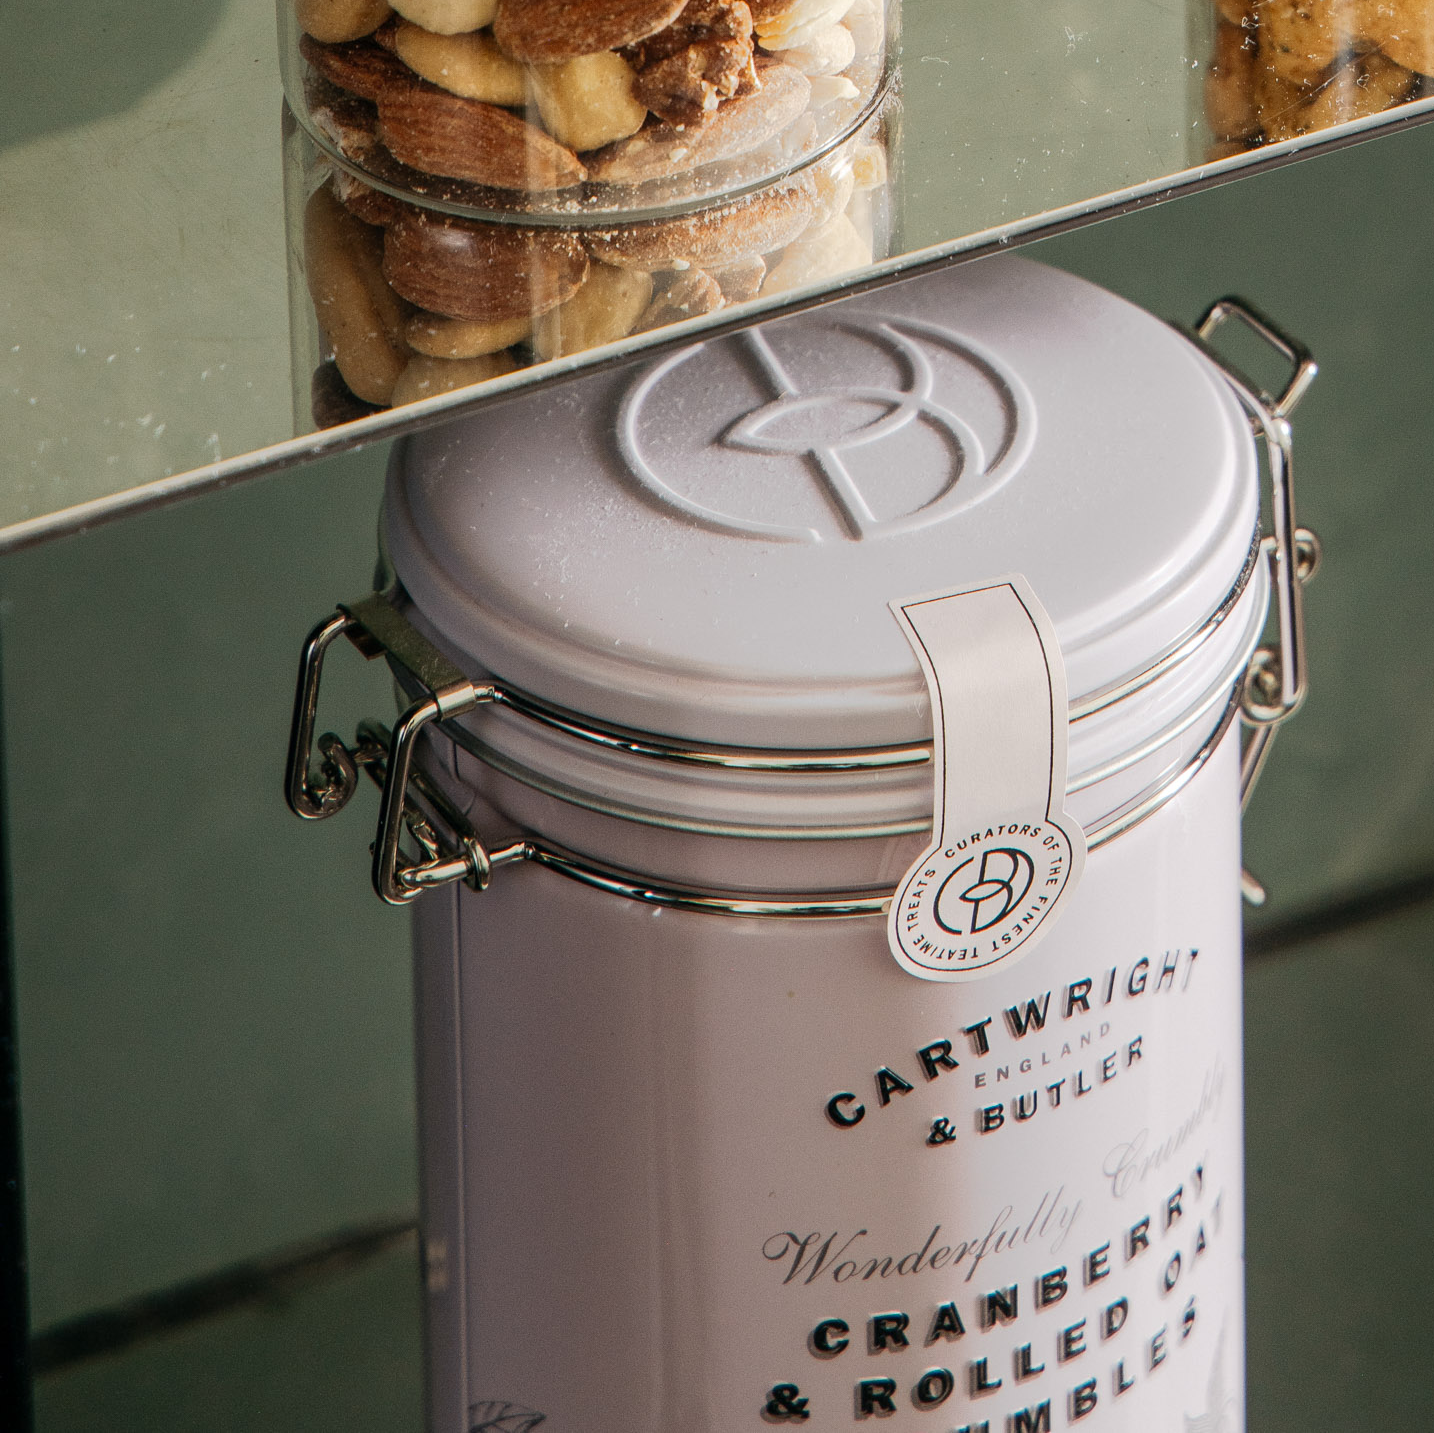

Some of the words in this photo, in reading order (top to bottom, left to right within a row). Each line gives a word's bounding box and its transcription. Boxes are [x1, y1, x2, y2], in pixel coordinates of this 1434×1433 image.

[944, 822, 1042, 859] CURATORS
[1042, 835, 1060, 852] OF
[1045, 855, 1063, 887] THE
[906, 867, 937, 933] TREATS
[991, 894, 1049, 953] FINEST
[912, 934, 979, 962] TEATIME
[823, 947, 1200, 1130] CARTWRIGHT
[973, 1021, 1112, 1091] ENGLAND
[925, 1115, 958, 1149] &
[975, 1035, 1146, 1137] BUTLER
[760, 1183, 1086, 1287] Wonderfully
[807, 1153, 1208, 1361] CRANBERRY
[761, 1380, 811, 1424] &
[853, 1294, 1130, 1422] ROLLED
